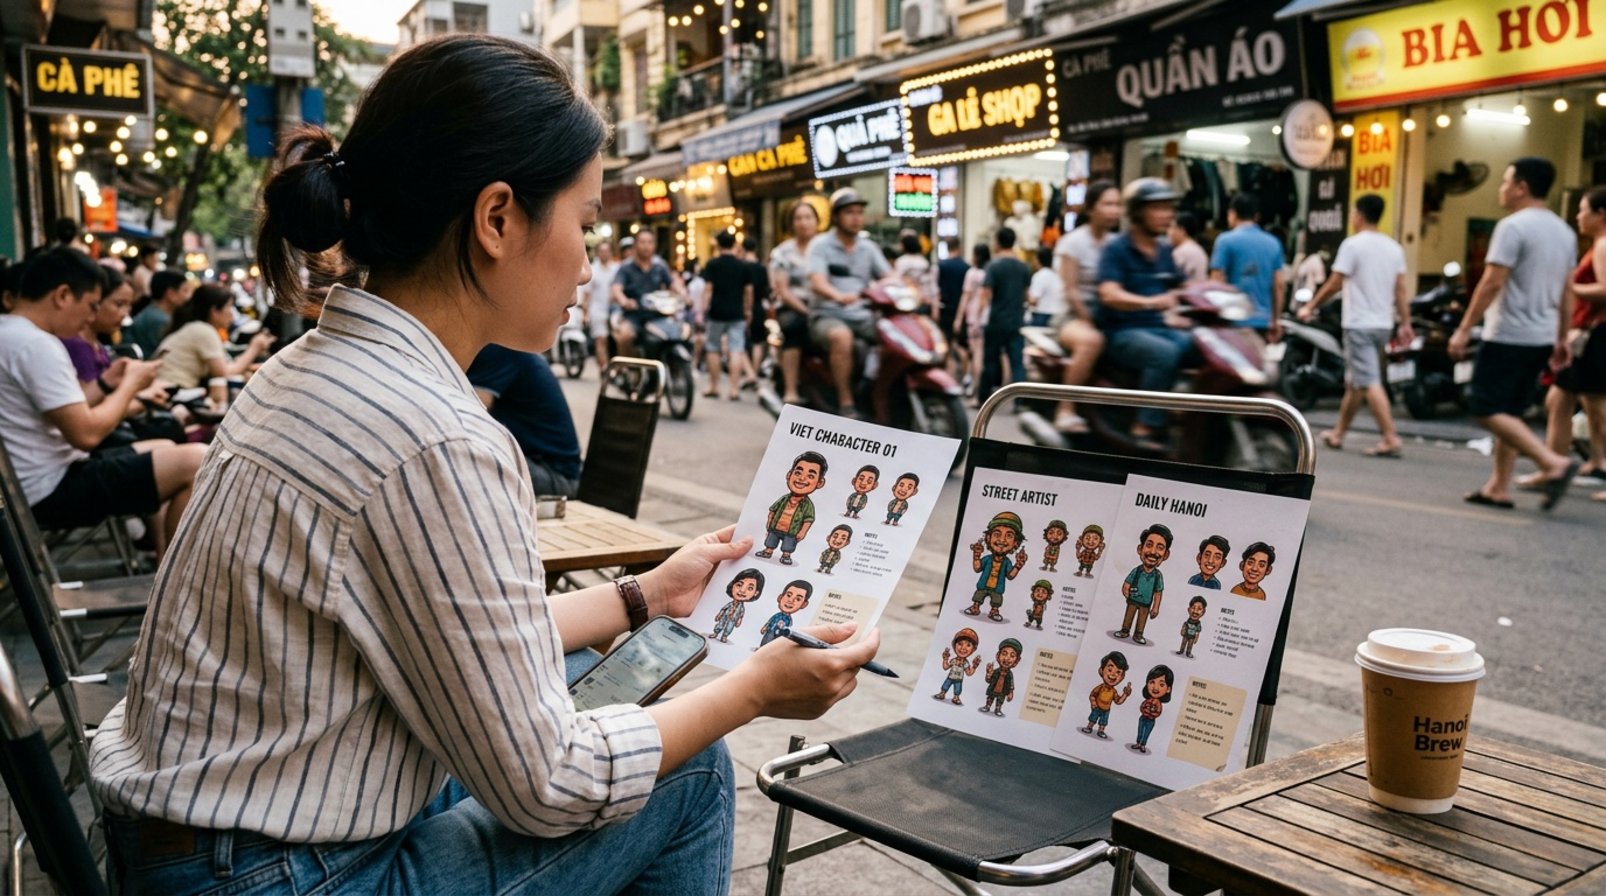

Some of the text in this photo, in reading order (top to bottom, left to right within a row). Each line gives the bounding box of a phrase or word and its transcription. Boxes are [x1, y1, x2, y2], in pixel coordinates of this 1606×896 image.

[1226, 26, 1286, 83] ÁO
[1401, 18, 1482, 68] BIA
[36, 57, 140, 98] CÀ PHÊ
[789, 421, 814, 439] VIET
[882, 443, 898, 458] 01
[982, 484, 1058, 506] STREET ARTIST
[1135, 492, 1208, 518] DAILY HANOI
[1413, 713, 1468, 734] Hanoi
[1414, 735, 1463, 752] Brew
